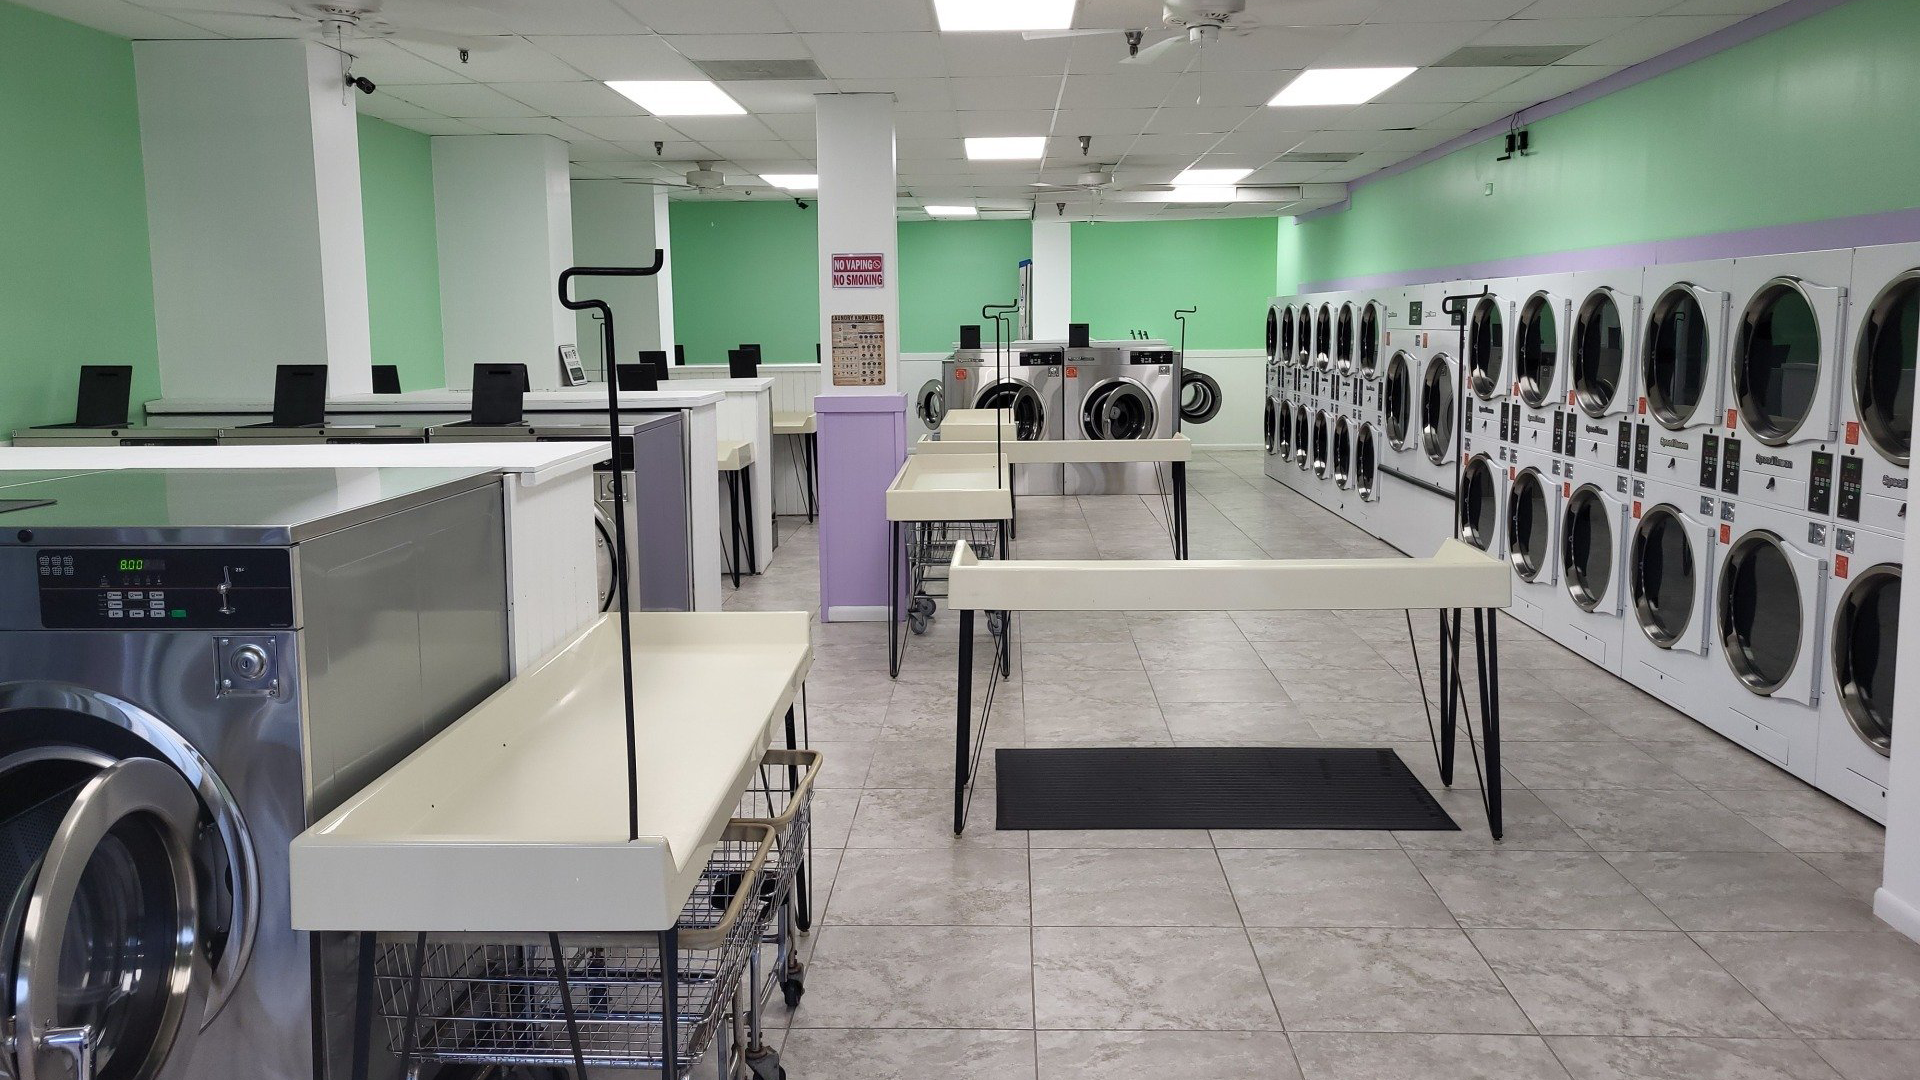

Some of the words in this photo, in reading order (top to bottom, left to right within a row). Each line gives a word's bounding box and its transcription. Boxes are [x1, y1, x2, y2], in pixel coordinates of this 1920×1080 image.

[834, 259, 845, 270] NO
[845, 259, 873, 270] VAPING
[833, 274, 845, 286] NO
[846, 273, 883, 286] SMOKING
[120, 559, 143, 570] 8.00
